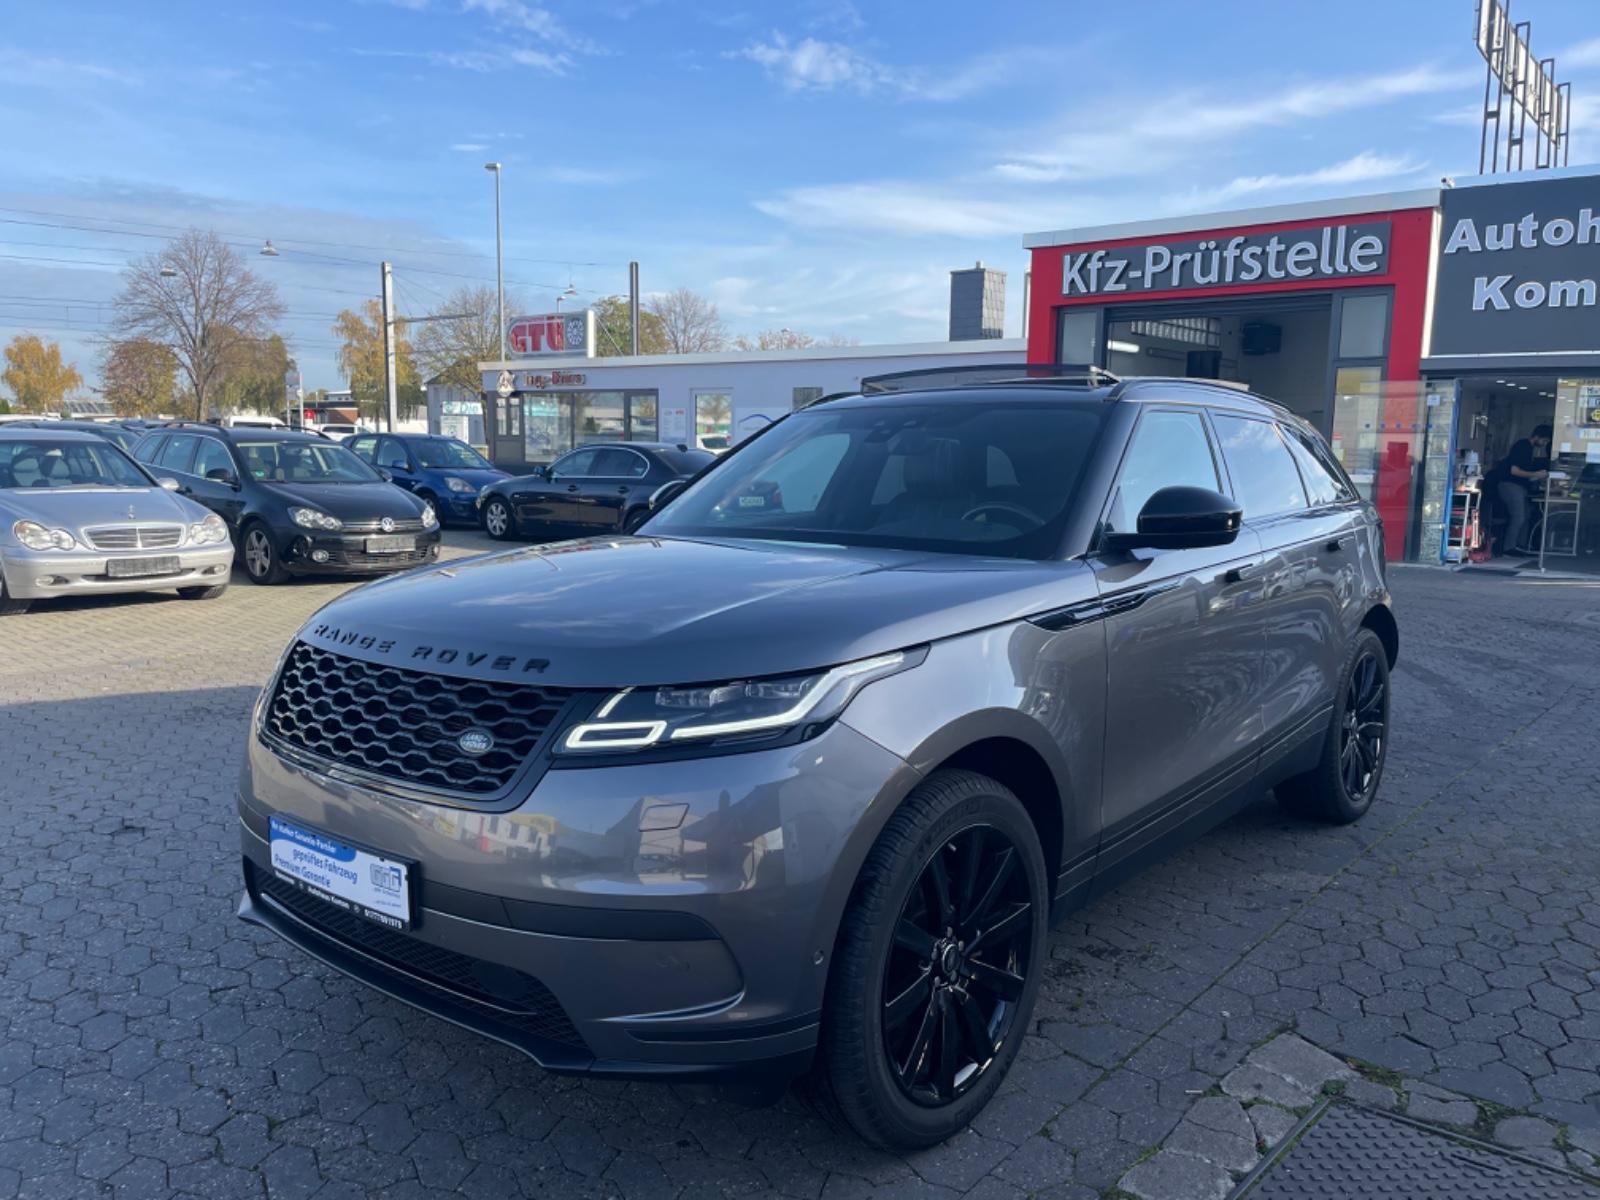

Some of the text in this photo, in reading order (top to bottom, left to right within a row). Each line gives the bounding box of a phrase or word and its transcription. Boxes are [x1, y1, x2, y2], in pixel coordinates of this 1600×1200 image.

[1444, 208, 1600, 254] Autoh
[1061, 225, 1383, 295] Kfz-Prüfstelle
[1472, 274, 1597, 311] Kom
[511, 315, 564, 352] GTÜ
[314, 624, 551, 673] RANGE ROVER
[275, 854, 301, 873] Premium
[302, 866, 330, 888] Garantie
[293, 849, 323, 869] geprüftes
[325, 859, 358, 885] Fahrzeug
